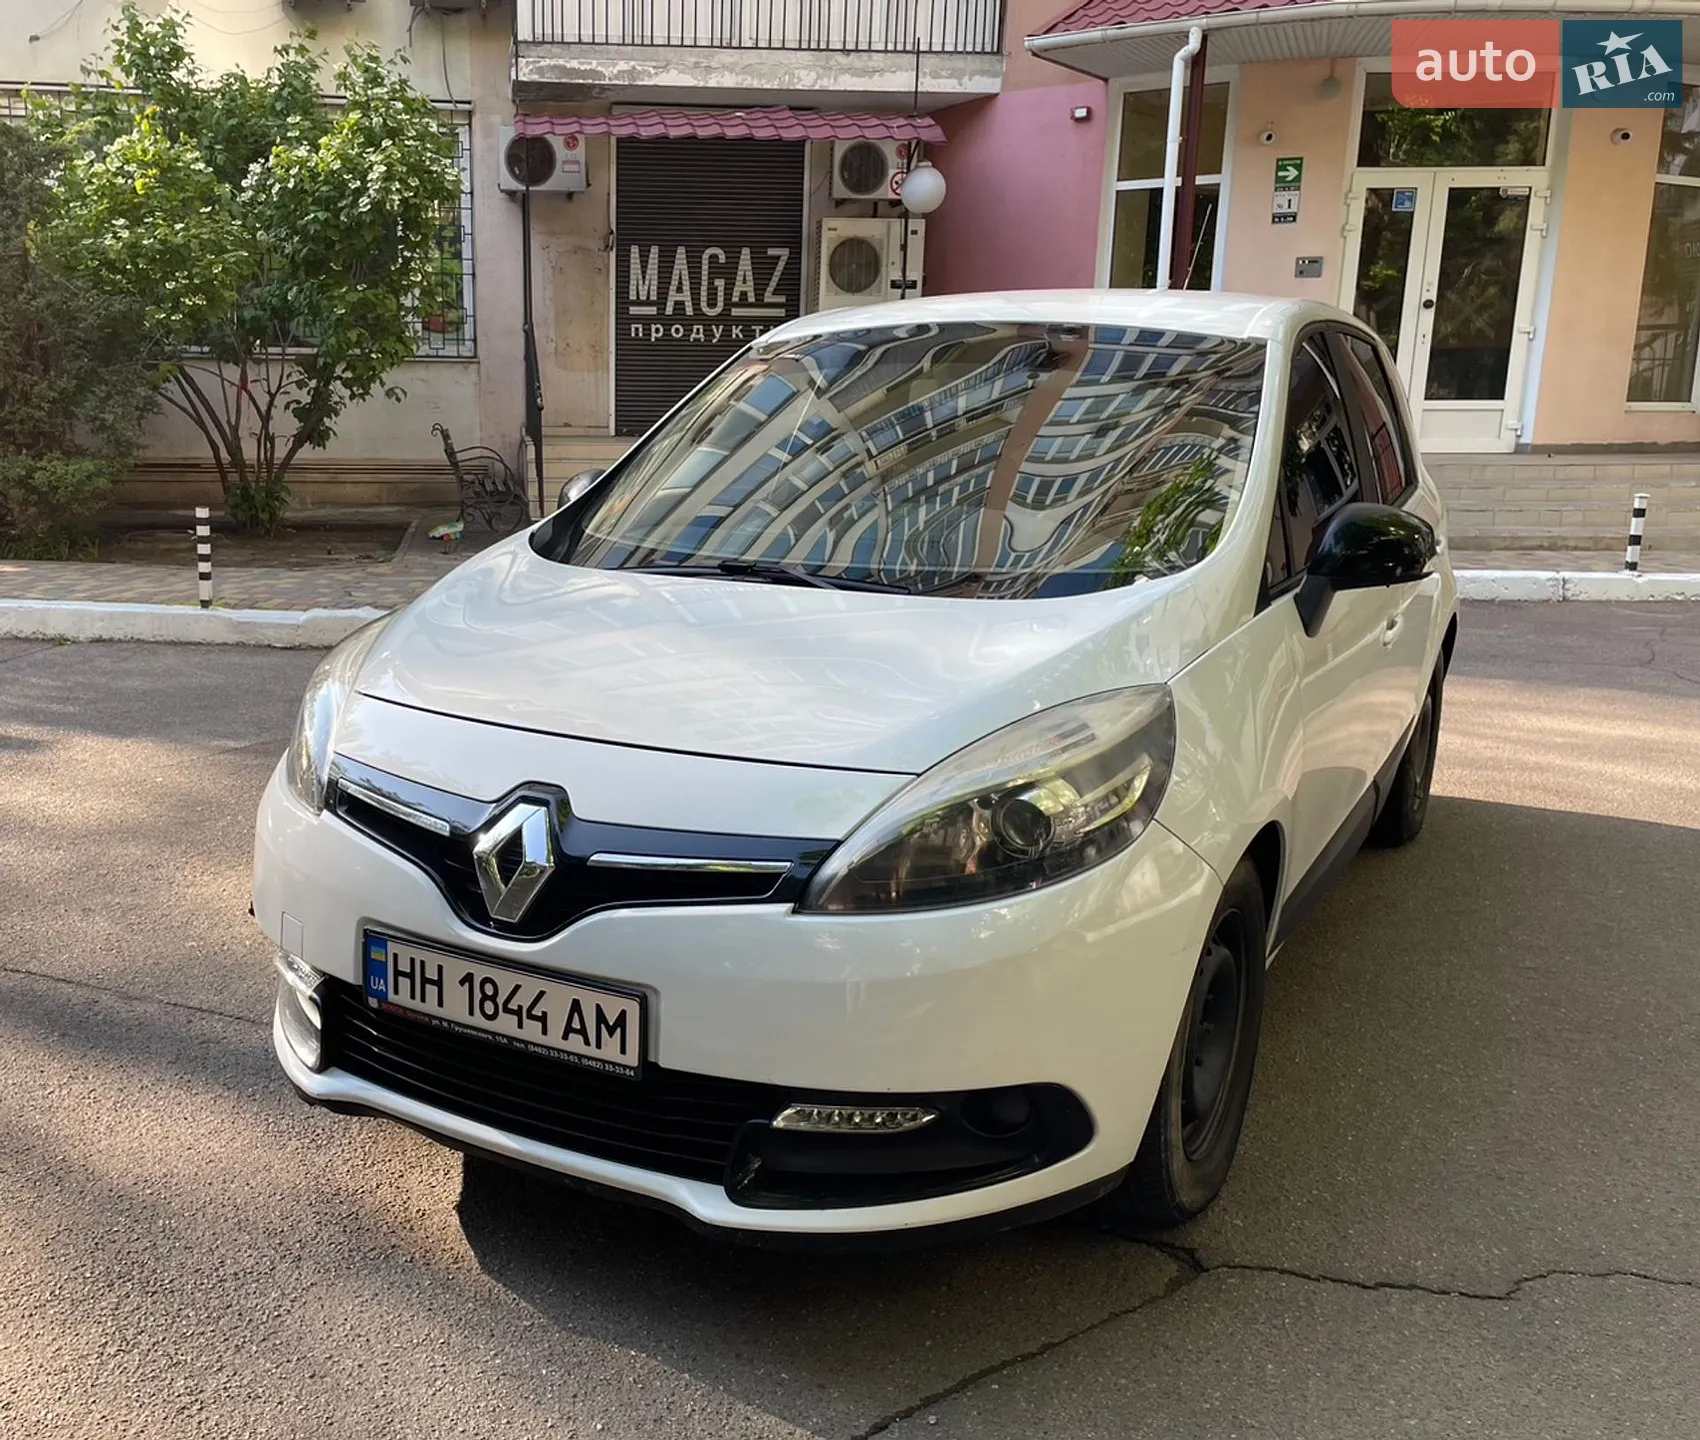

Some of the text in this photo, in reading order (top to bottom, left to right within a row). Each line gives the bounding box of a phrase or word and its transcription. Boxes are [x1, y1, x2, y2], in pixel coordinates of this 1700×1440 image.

[629, 245, 790, 316] MAGAZ
[630, 323, 776, 344] продукт
[370, 975, 386, 992] UA
[458, 972, 548, 1036] 1844
[561, 998, 627, 1055] AM
